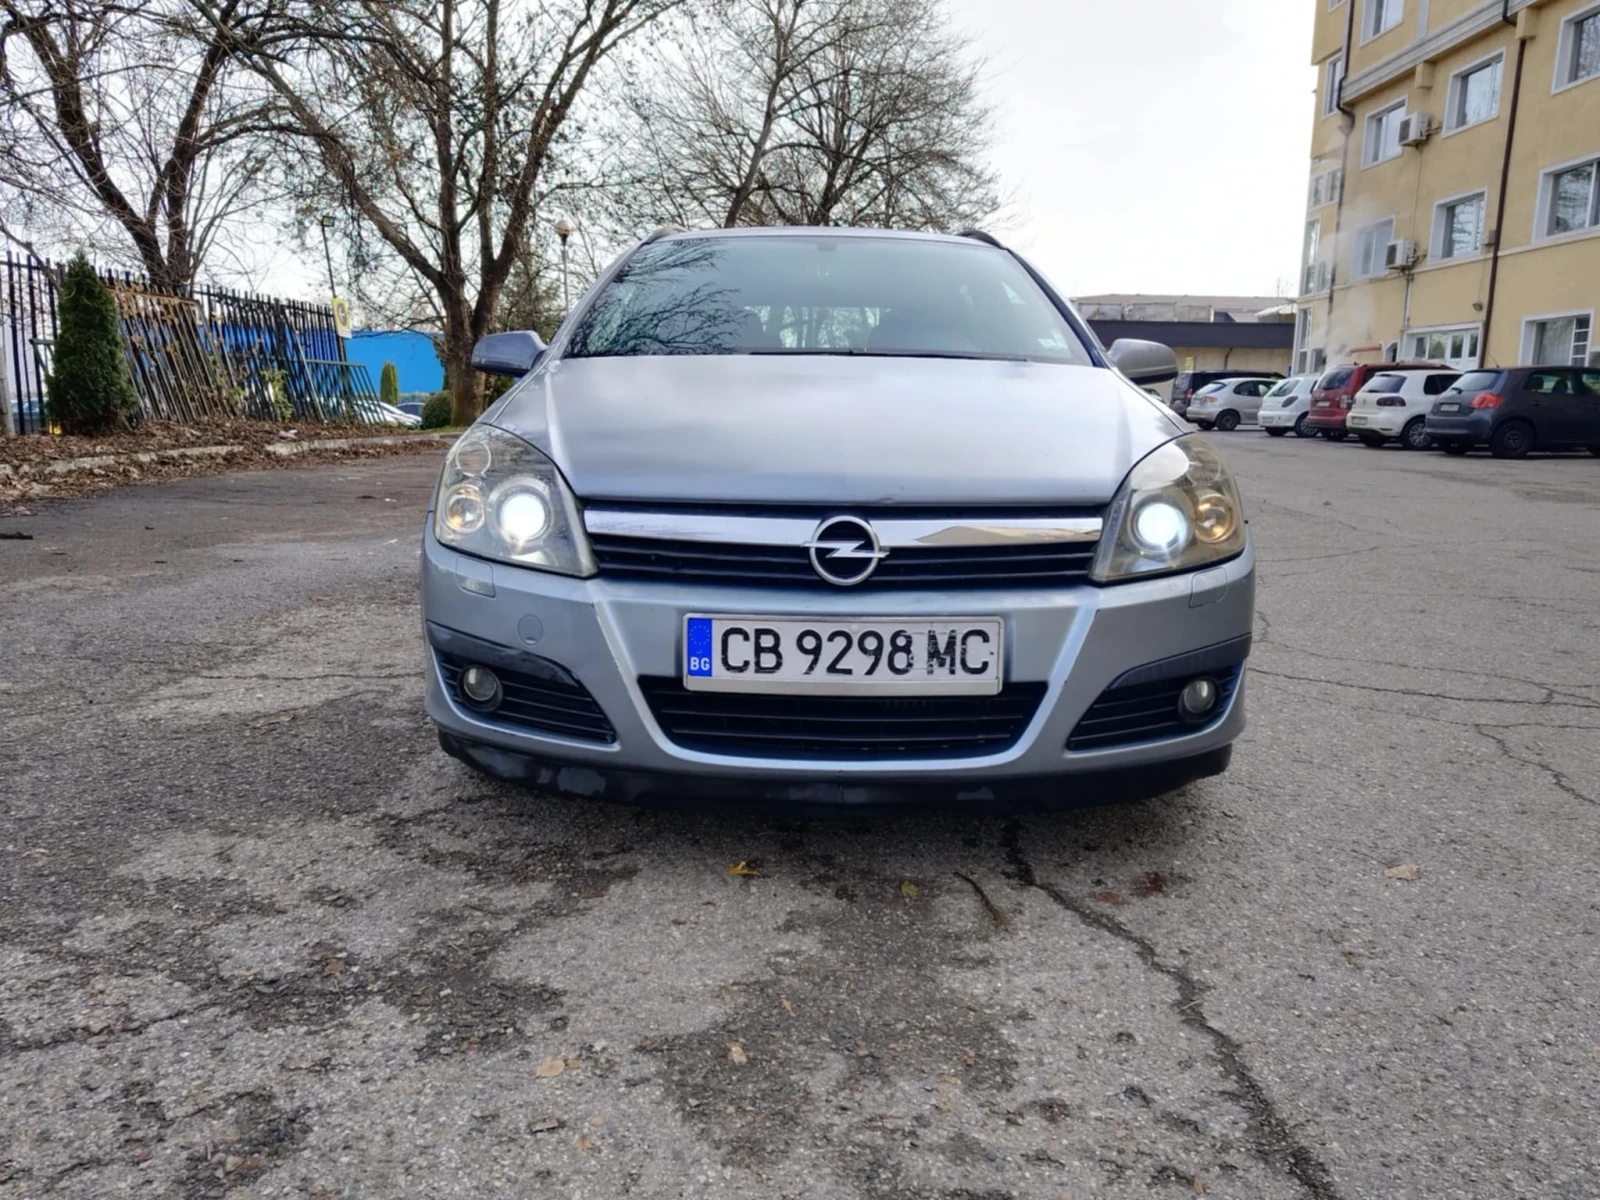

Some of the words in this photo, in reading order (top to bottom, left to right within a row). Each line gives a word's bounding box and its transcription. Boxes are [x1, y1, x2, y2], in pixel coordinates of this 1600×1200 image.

[690, 656, 711, 671] BG
[720, 626, 783, 675] CB
[796, 629, 914, 676] 9298
[927, 628, 990, 675] MC
